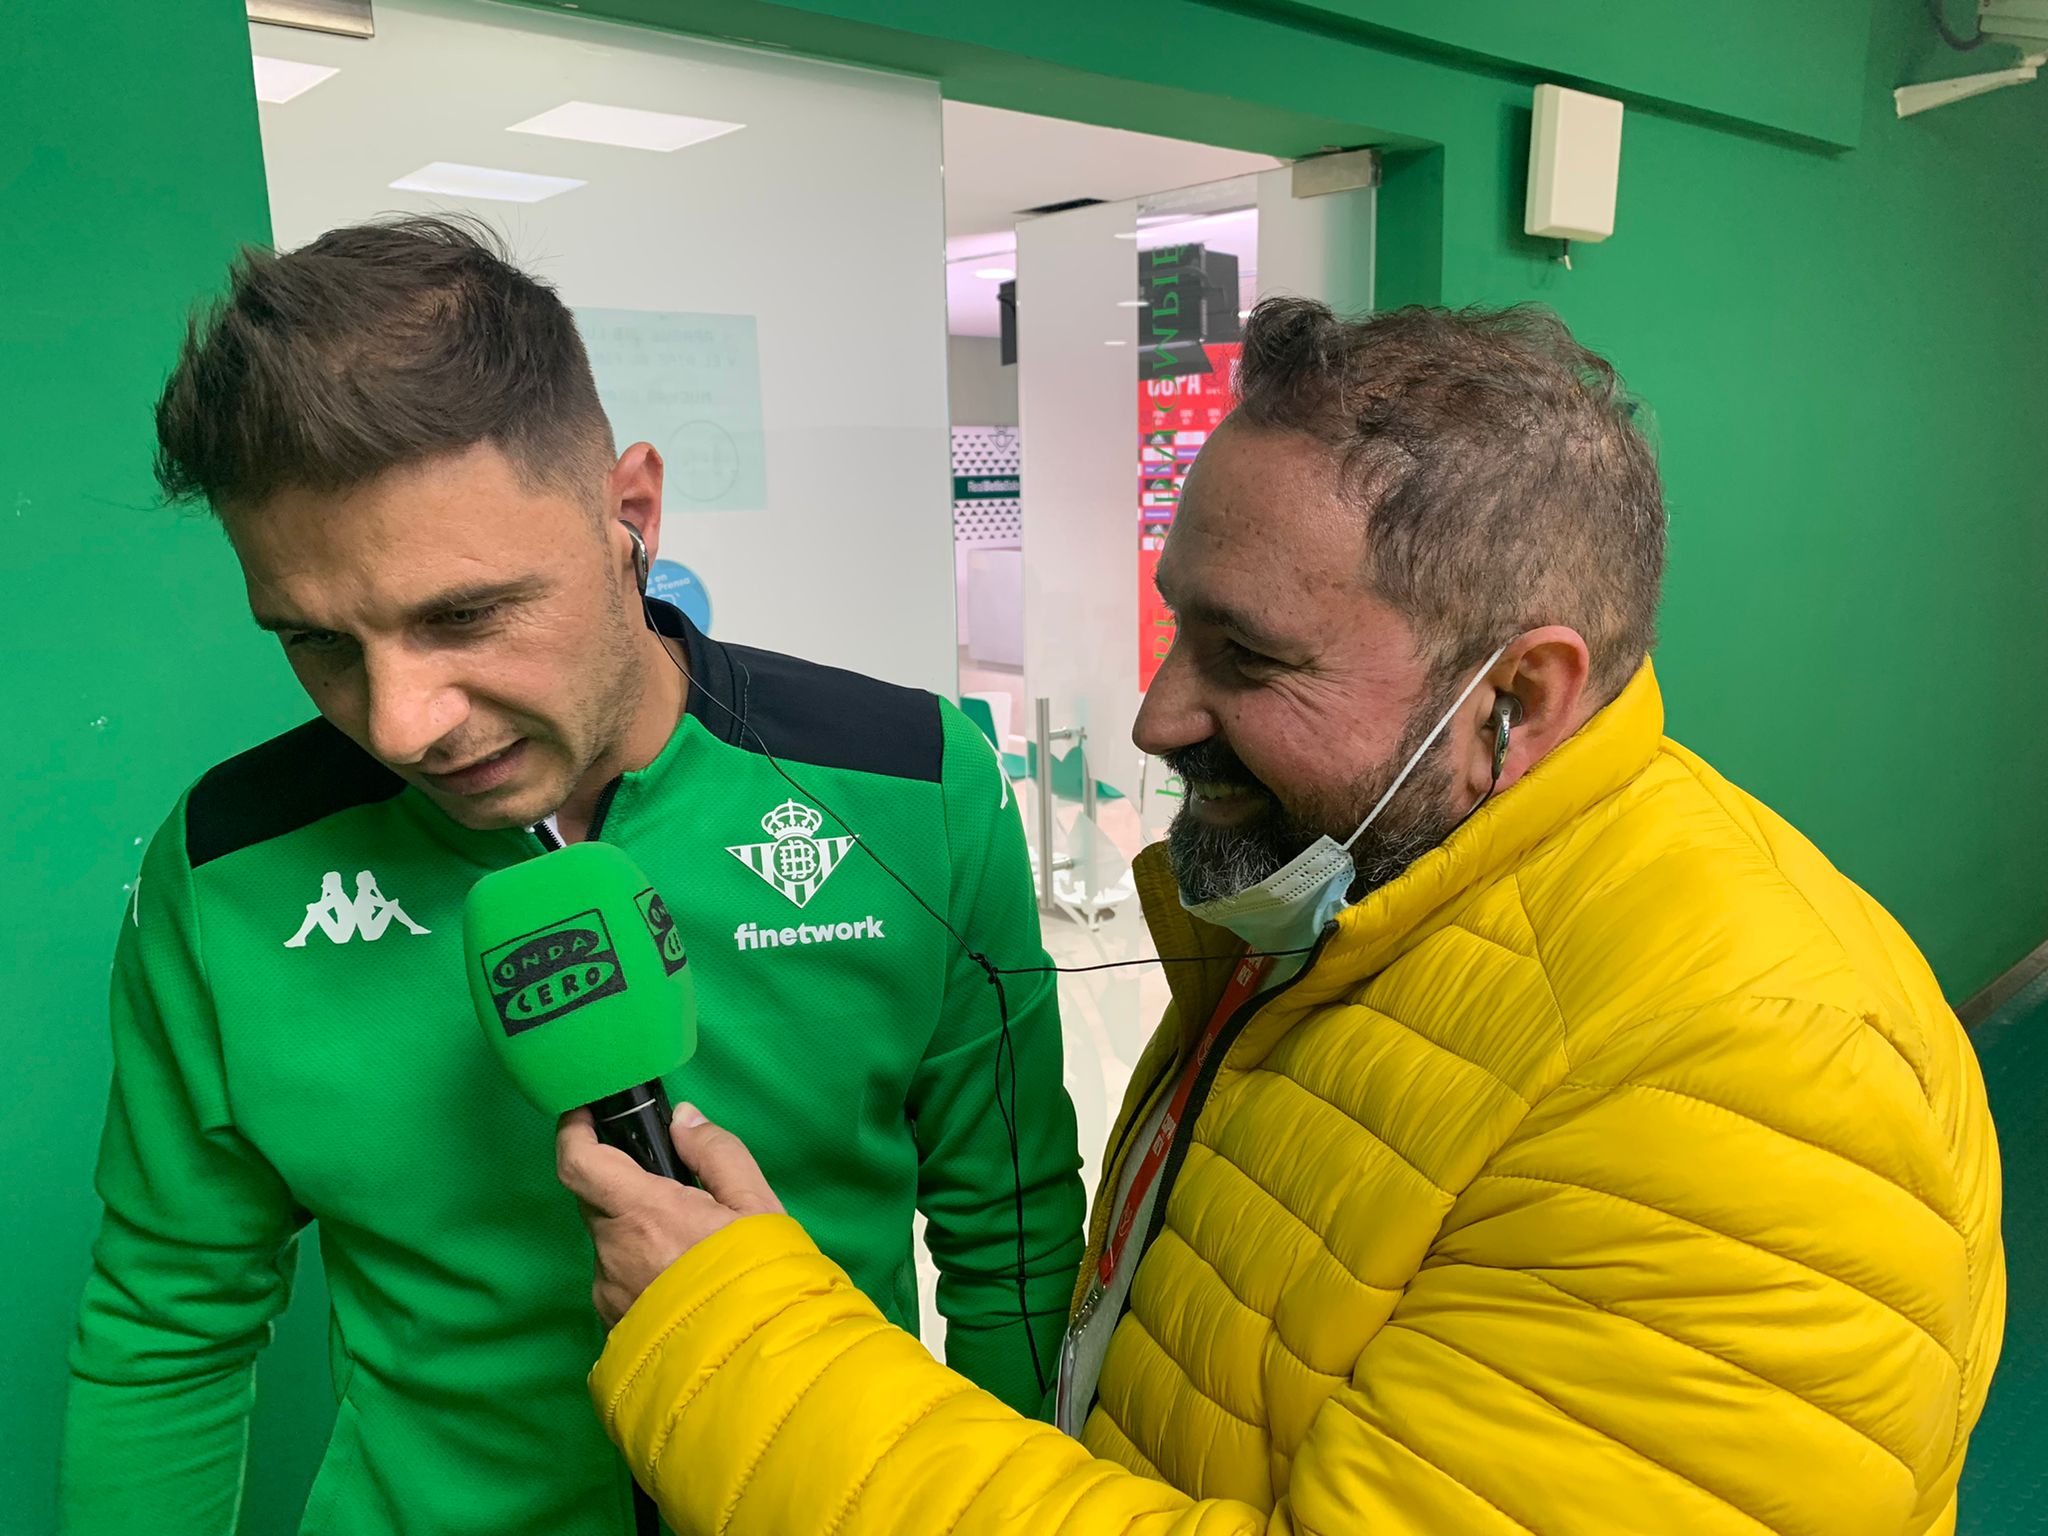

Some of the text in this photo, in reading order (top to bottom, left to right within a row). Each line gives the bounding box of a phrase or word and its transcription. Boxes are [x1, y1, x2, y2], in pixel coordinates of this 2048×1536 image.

[734, 915, 885, 951] finetwork
[501, 936, 588, 980] ONDA
[516, 966, 601, 1013] CERO
